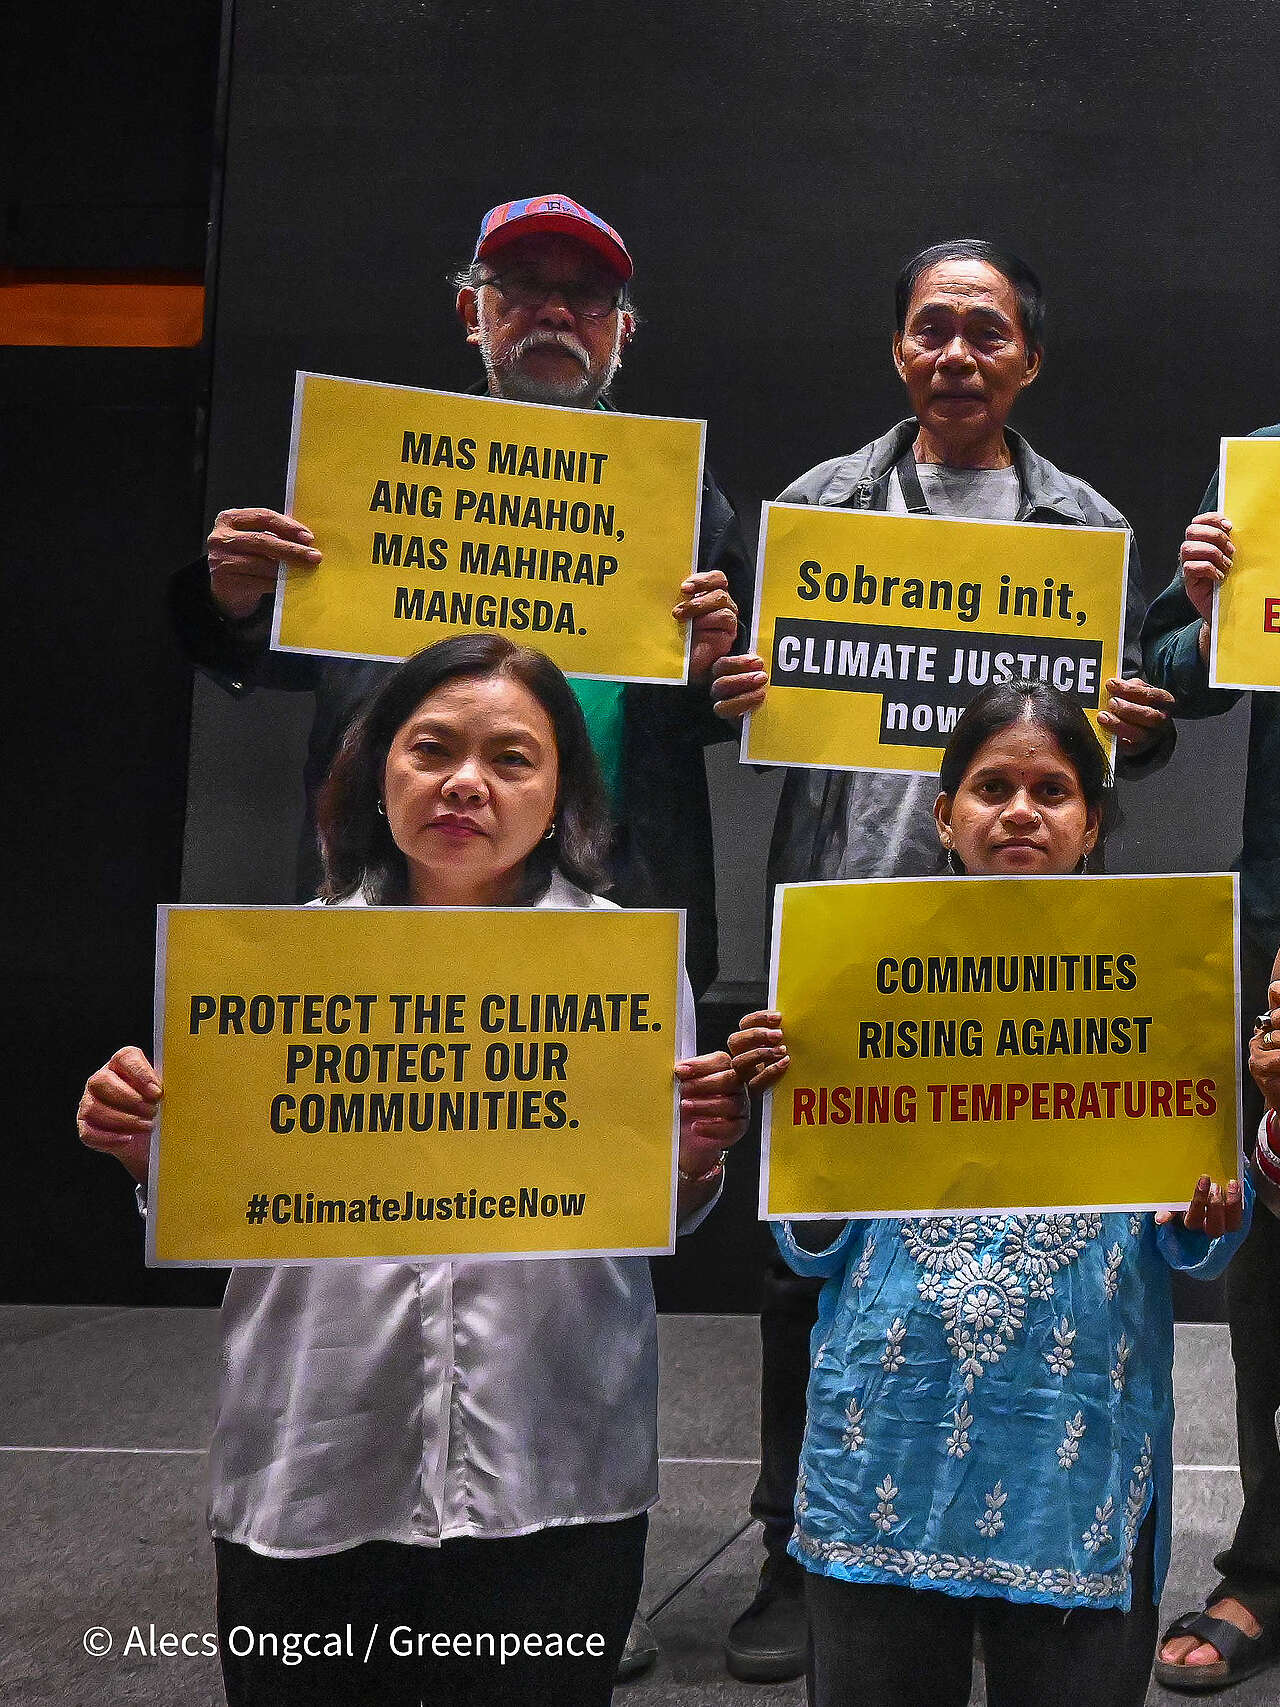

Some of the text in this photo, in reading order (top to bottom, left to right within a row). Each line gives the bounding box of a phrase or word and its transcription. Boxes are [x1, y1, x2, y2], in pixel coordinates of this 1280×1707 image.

[401, 431, 609, 485] MAS MAINIT
[369, 479, 625, 543] ANG PANAHON,
[371, 532, 619, 587] MAS MAHIRAP
[393, 588, 587, 636] MANGISDA.
[796, 560, 1087, 627] Sobrang init,
[777, 636, 1097, 694] CLIMATE JUSTICE
[875, 953, 1138, 995] COMMUNITIES
[189, 993, 662, 1035] PROTECT THE CLIMATE.
[858, 1016, 1153, 1059] RISING AGAINST
[285, 1042, 569, 1084] PROTECT OUR
[269, 1090, 580, 1134] COMMUNITIES.
[792, 1078, 1218, 1126] RISING TEMPERATURES
[245, 1187, 586, 1225] #ClimateJusticeNow
